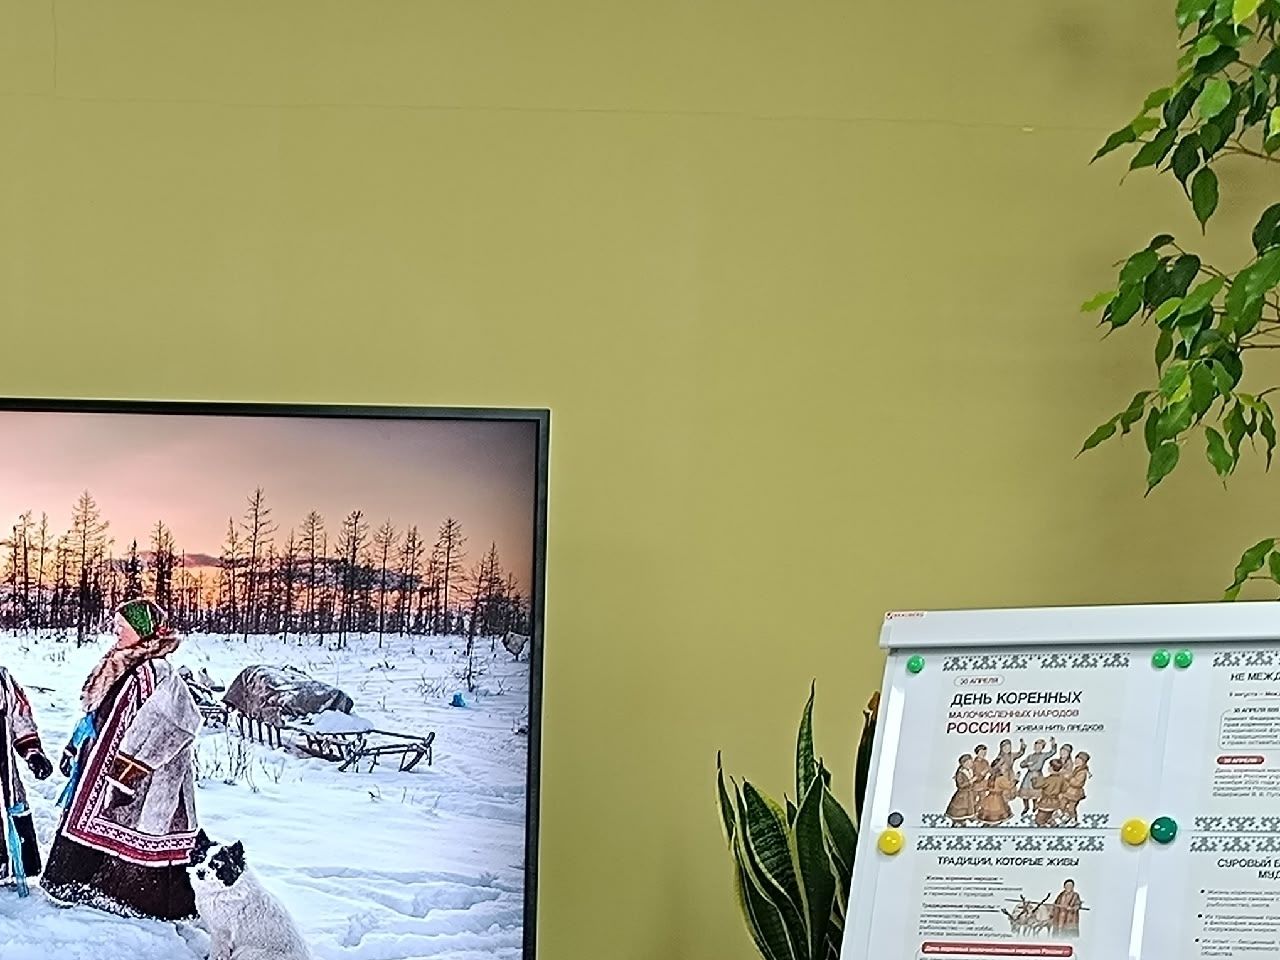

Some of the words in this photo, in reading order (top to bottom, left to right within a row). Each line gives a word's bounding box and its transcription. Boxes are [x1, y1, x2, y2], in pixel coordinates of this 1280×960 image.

[950, 693, 992, 707] ДЕНЬ
[997, 691, 1082, 704] КОРЕННЫХ
[949, 711, 1030, 719] МАЛОЧИСЛЕННЫХ
[1033, 710, 1079, 718] НАРОДОВ
[947, 722, 1011, 734] РОССИИ
[938, 857, 993, 866] ТРАДИЦИИ,
[995, 858, 1043, 866] КОТОРЫЕ
[1047, 858, 1079, 866] ЖИВЫ
[1218, 856, 1271, 868] СУРОВЫЙ
